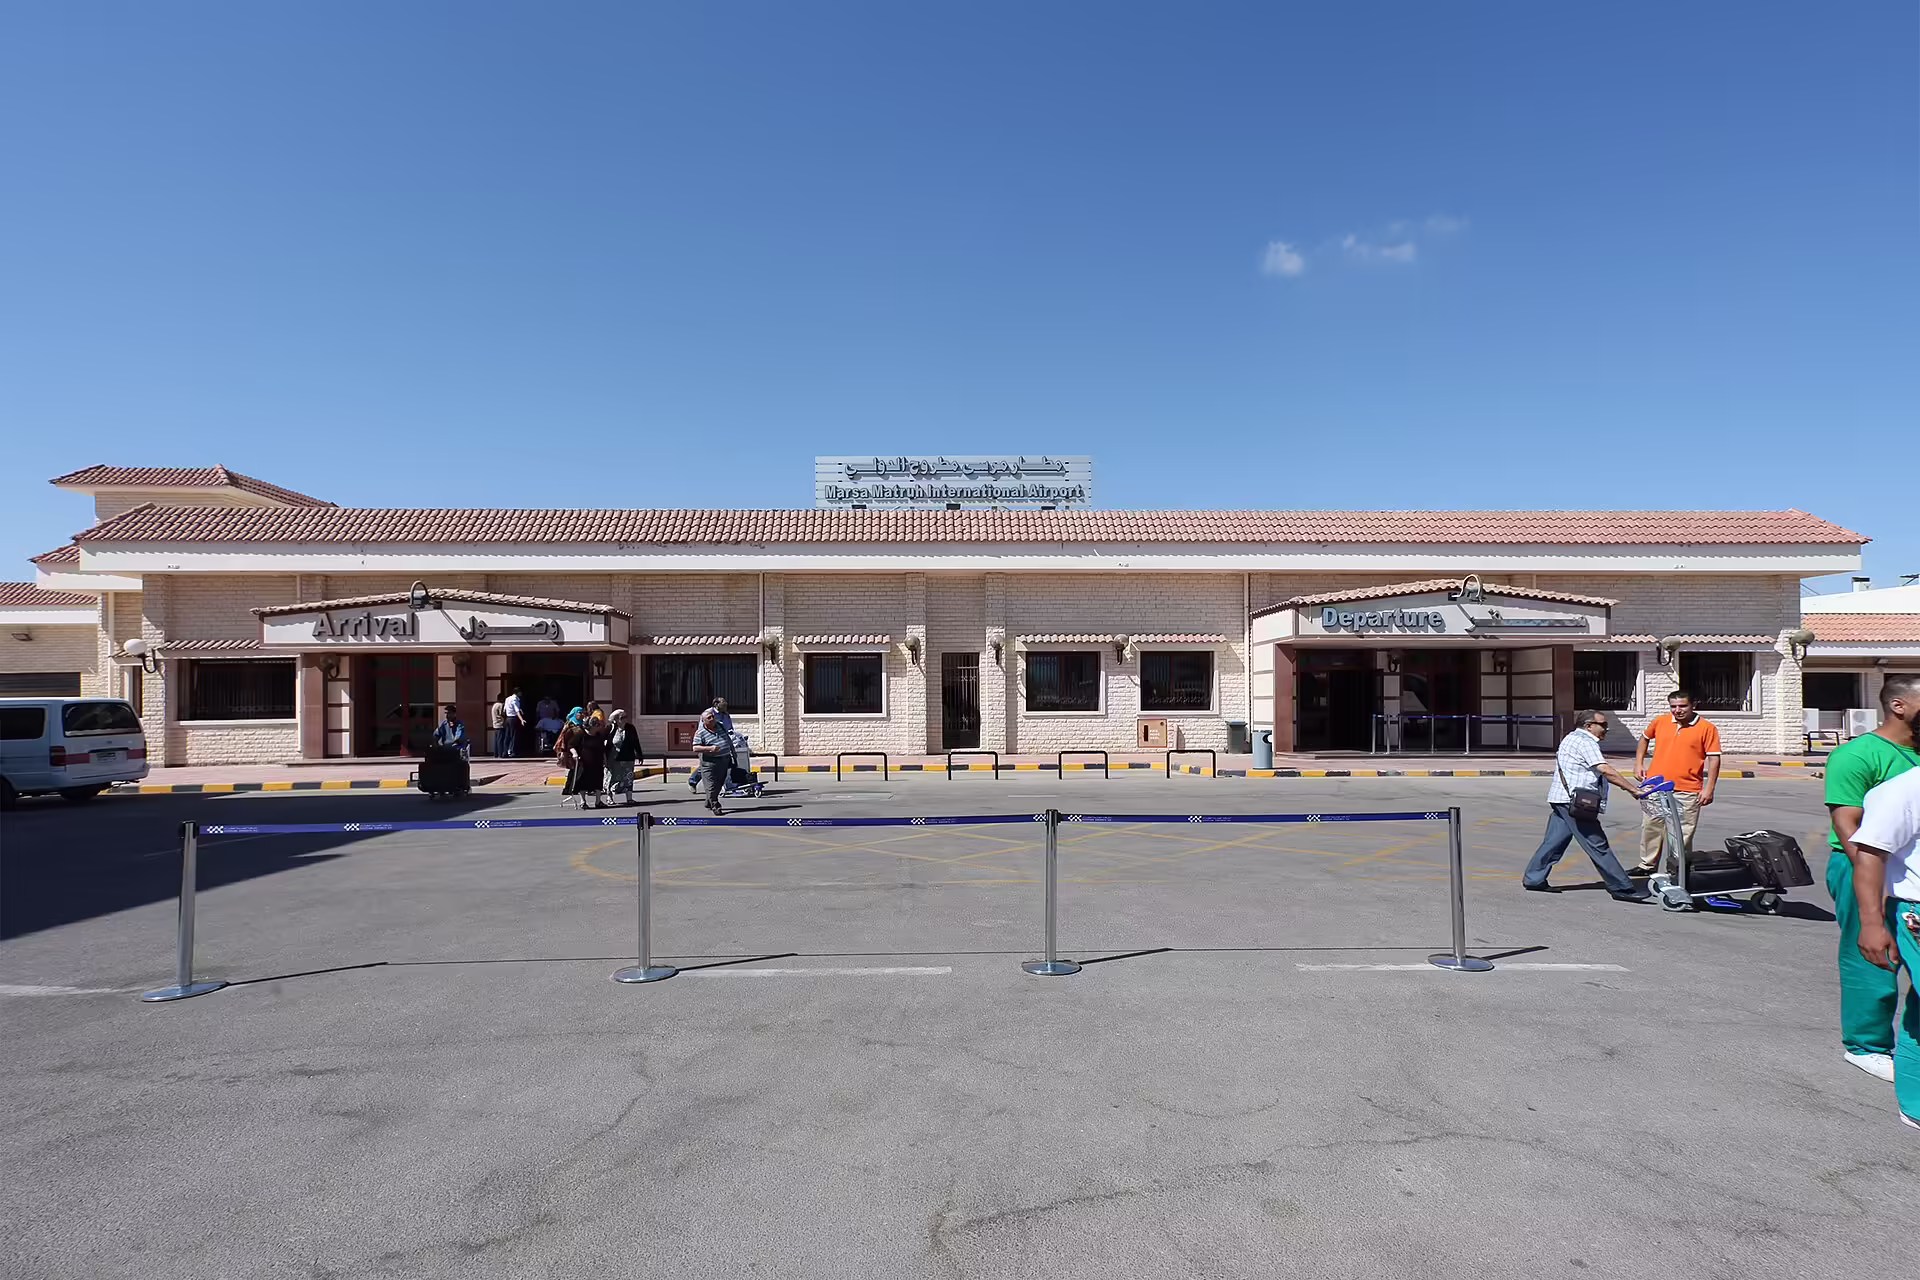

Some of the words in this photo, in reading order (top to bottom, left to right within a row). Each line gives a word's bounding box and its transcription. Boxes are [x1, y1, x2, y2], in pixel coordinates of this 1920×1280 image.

[909, 456, 961, 476] مطروح
[1009, 456, 1064, 475] مطار
[825, 484, 869, 499] Marsa
[872, 483, 924, 499] Matruh
[927, 483, 1024, 499] International
[1028, 483, 1082, 502] Airport
[312, 612, 416, 638] Arrival
[460, 616, 559, 640] وصول
[1321, 608, 1443, 631] Departure
